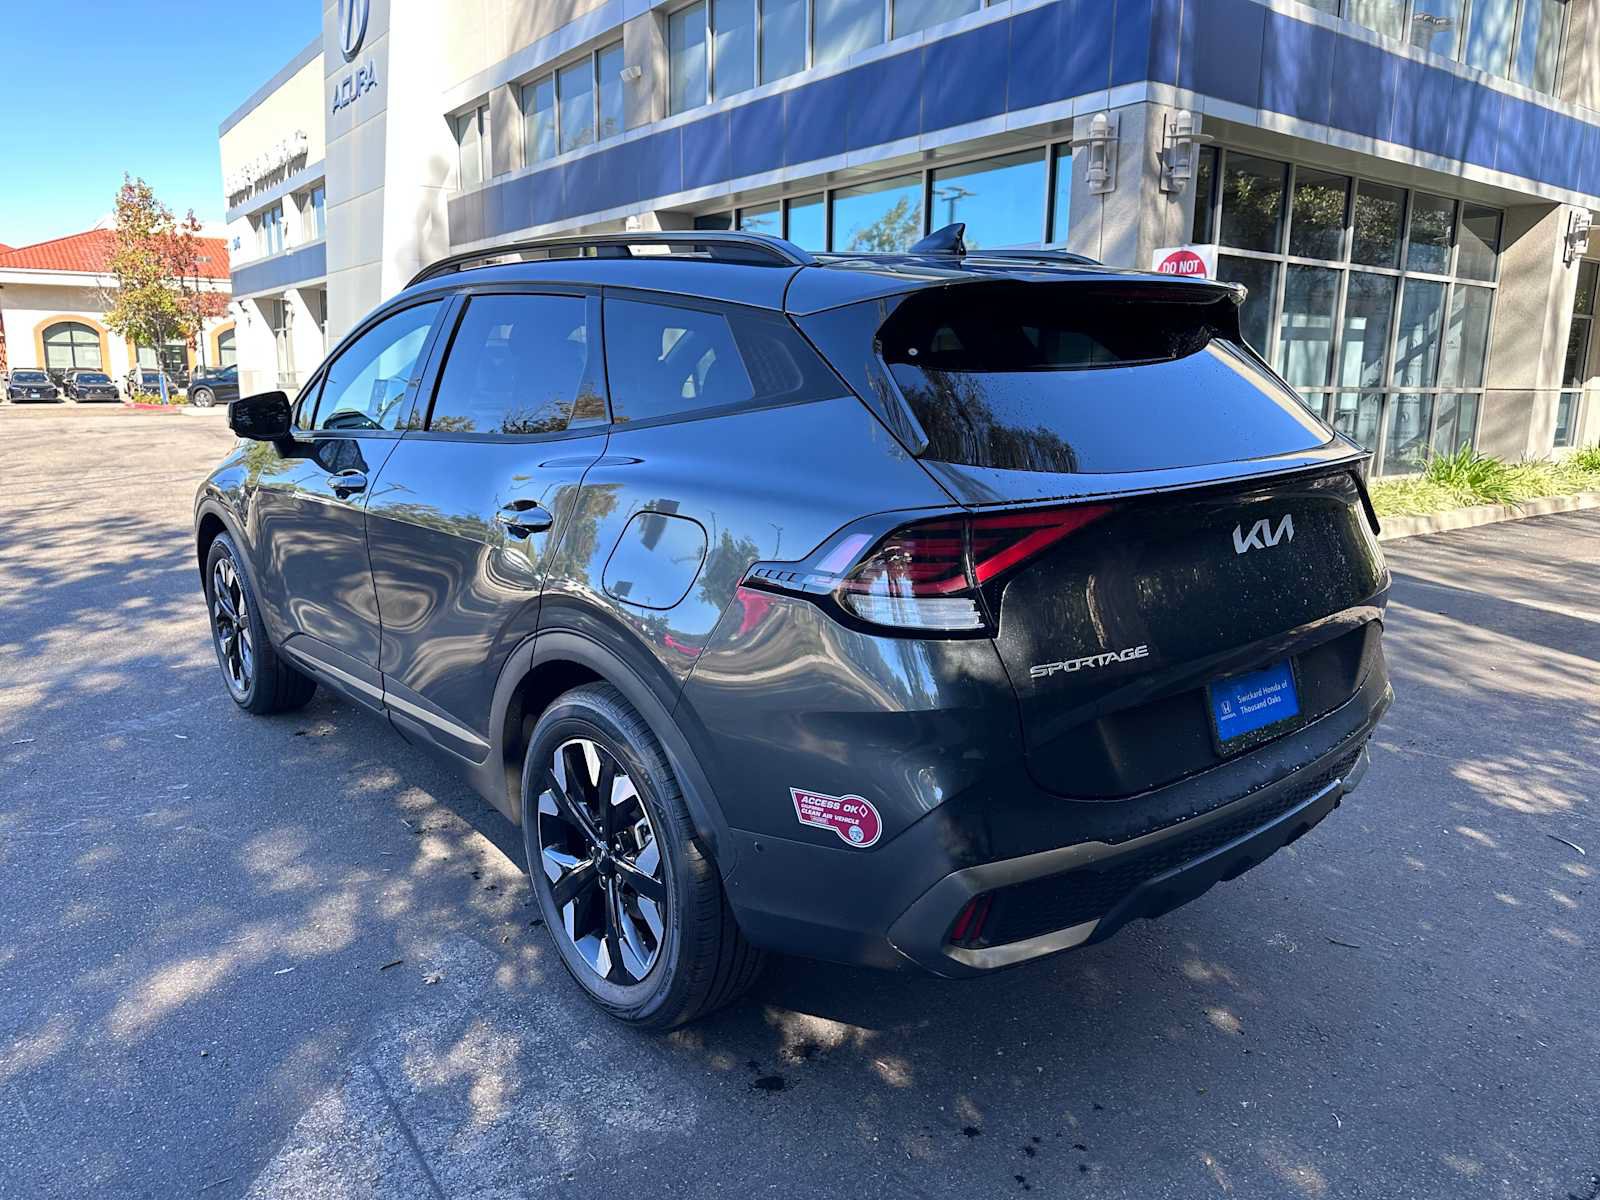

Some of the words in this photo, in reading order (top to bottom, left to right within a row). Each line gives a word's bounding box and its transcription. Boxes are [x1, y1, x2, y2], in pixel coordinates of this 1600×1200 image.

[332, 60, 378, 116] ACURA
[1162, 262, 1177, 273] DO
[1179, 259, 1200, 272] NOT
[1232, 513, 1295, 554] KIA
[1029, 644, 1150, 678] SPORTAGE
[1237, 688, 1262, 704] Swickard
[1262, 682, 1281, 696] Honda
[1281, 680, 1288, 689] of
[1240, 700, 1267, 715] Thousand
[1266, 695, 1282, 706] Oaks
[801, 796, 841, 810] ACCESS
[843, 804, 859, 814] OK
[801, 808, 821, 817] CLEAN
[834, 815, 860, 825] VEHICLE
